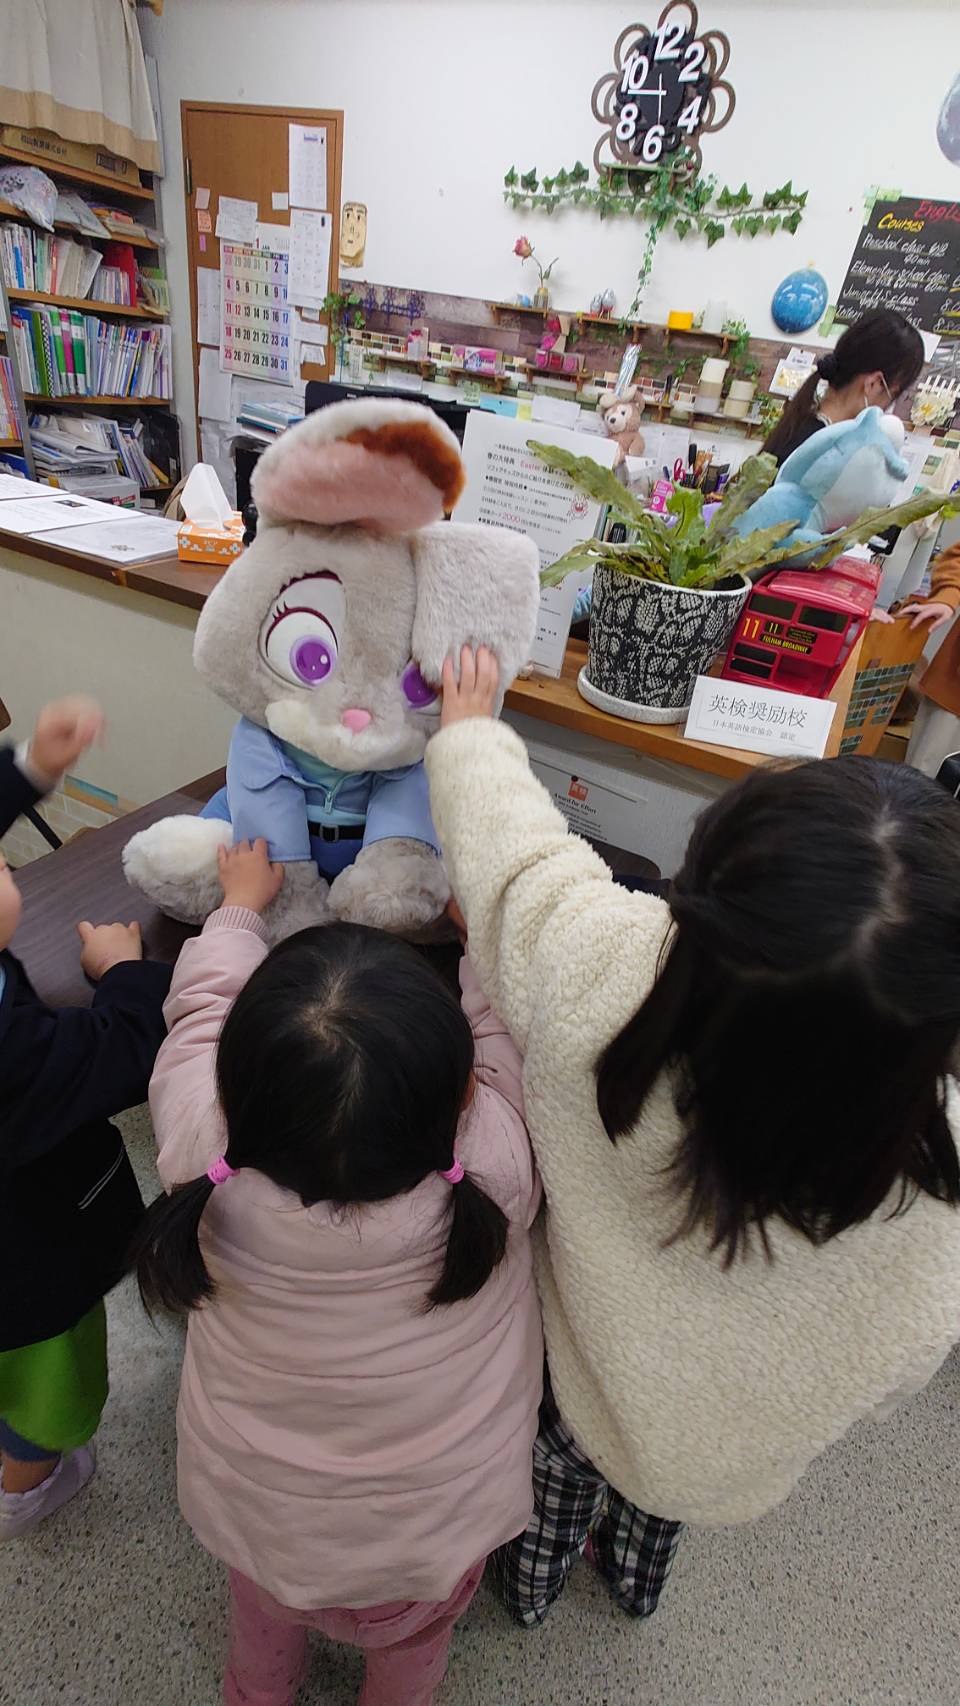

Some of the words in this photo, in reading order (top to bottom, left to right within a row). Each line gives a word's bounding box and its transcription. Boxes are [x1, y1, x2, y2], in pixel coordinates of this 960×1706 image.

[654, 22, 686, 61] 12
[620, 50, 649, 93] 10
[678, 41, 705, 83] 2
[615, 103, 639, 141] 8
[677, 96, 703, 135] 4
[642, 124, 666, 163] 6
[878, 212, 925, 232] Courses
[862, 233, 902, 249] Preschool
[264, 260, 269, 272] 1
[274, 261, 279, 273] 2
[226, 279, 231, 290] 4
[235, 280, 240, 292] 5
[245, 281, 250, 293] 6
[255, 283, 259, 295] 7
[264, 284, 269, 296] 8
[274, 286, 279, 298] 9
[226, 303, 232, 314] 11
[235, 304, 241, 316] 12
[244, 306, 251, 317] 13
[253, 307, 260, 319] 14
[263, 309, 270, 321] 15
[272, 310, 279, 322] 16
[282, 312, 289, 324] 17
[225, 326, 232, 337] 18
[234, 327, 241, 339] 19
[243, 329, 251, 341] 20
[252, 330, 260, 342] 21
[261, 332, 270, 344] 22
[271, 334, 279, 346] 23
[281, 336, 289, 348] 24
[224, 348, 232, 360] 25
[233, 350, 242, 362] 26
[243, 352, 251, 364] 27
[252, 353, 260, 365] 28
[261, 355, 269, 367] 29
[270, 357, 279, 369] 30
[280, 359, 288, 371] 31
[742, 617, 761, 639] 11
[768, 622, 779, 635] 11
[762, 634, 783, 647] FULHAM
[781, 641, 809, 654] BROADWAY
[707, 693, 808, 728] 英検奨励校
